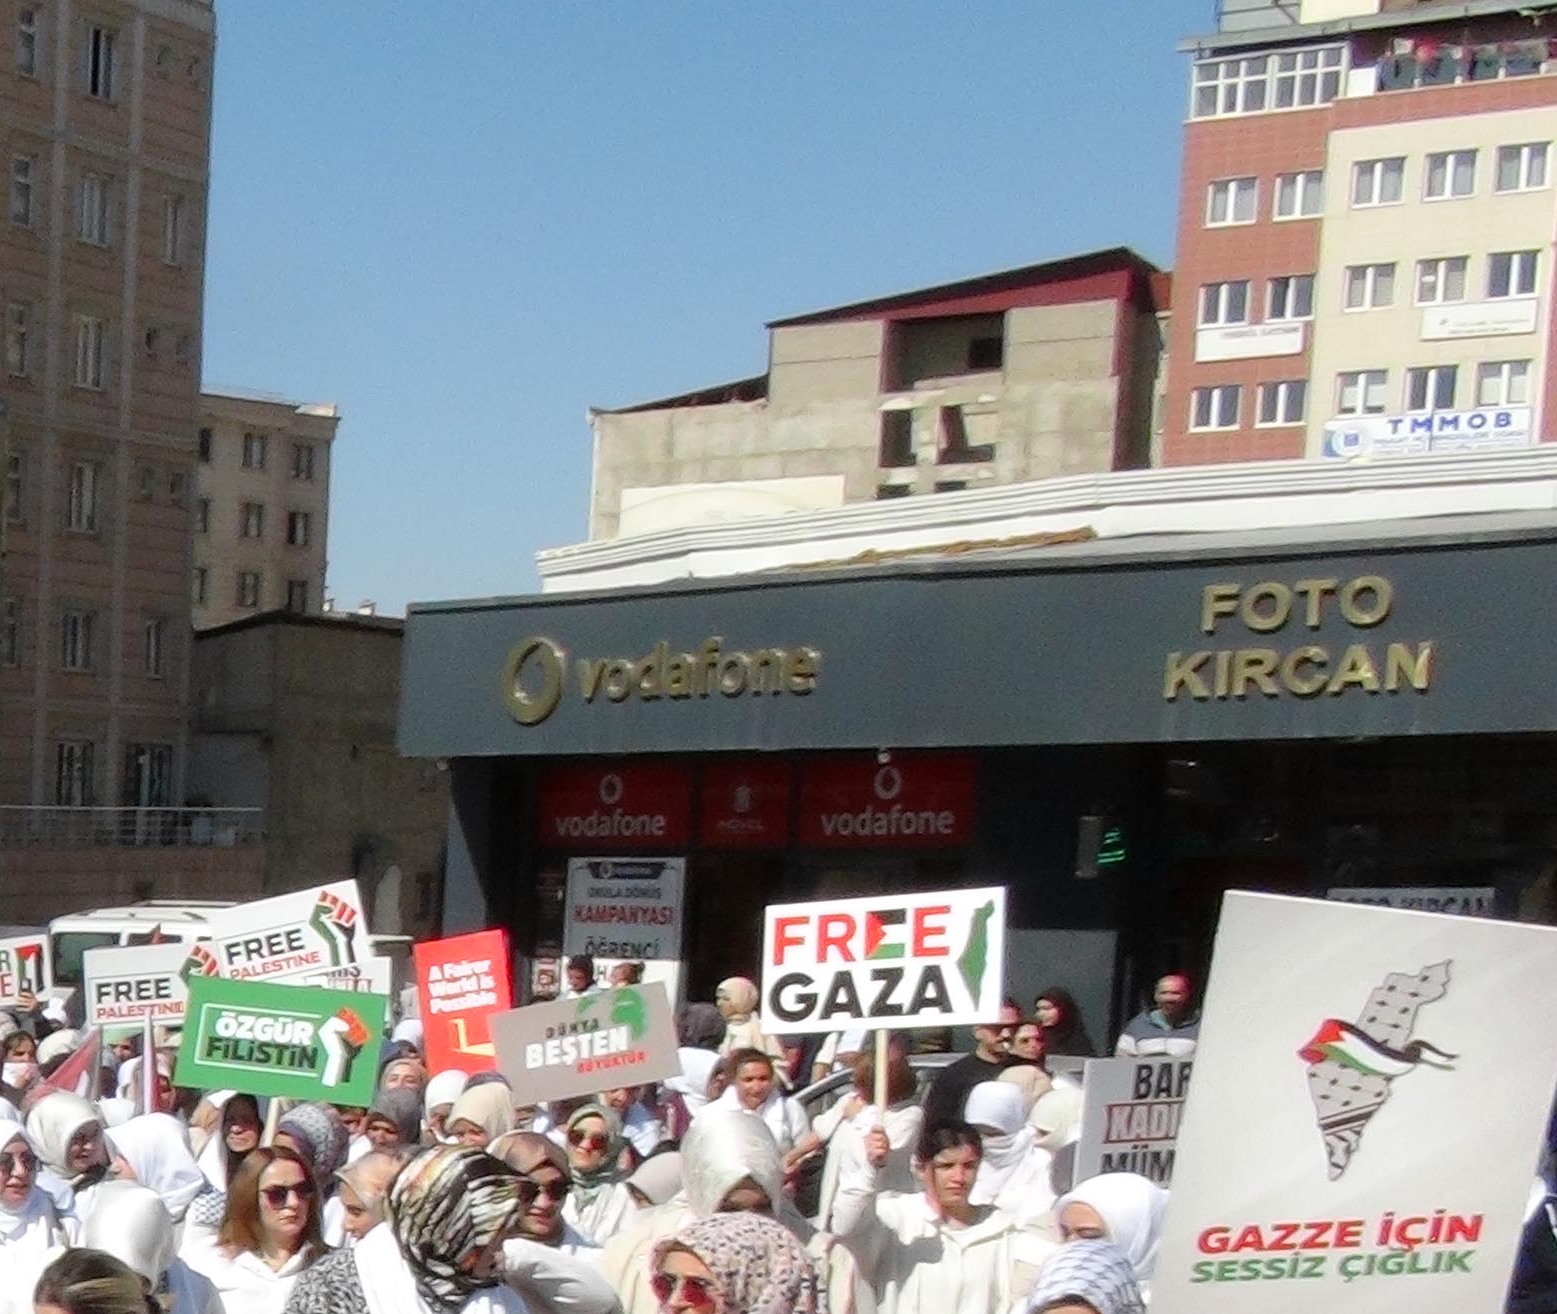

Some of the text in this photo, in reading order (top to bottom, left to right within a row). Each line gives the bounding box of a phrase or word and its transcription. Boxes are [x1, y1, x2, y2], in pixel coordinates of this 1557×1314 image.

[1387, 412, 1512, 434] TMMOB
[1200, 574, 1394, 635] FOTO
[577, 636, 822, 705] vodafone
[1161, 640, 1436, 702] KIRCAN
[555, 807, 666, 837] vodafone
[821, 805, 956, 836] vodafone
[573, 904, 676, 926] KAMPANYASI
[224, 928, 307, 966] FREE
[773, 905, 952, 966] FREE
[228, 951, 323, 980] PALESTINE
[428, 959, 493, 982] A Fairer
[95, 976, 173, 1005] FREE
[427, 973, 496, 998] World is
[429, 990, 498, 1014] Possible
[768, 964, 954, 1023] GAZA
[96, 1000, 185, 1020] PALESTINE
[214, 1011, 316, 1046] ÖZGÜR
[544, 1017, 600, 1040] DÜNYA
[204, 1036, 318, 1070] FİLİSTİN
[525, 1026, 631, 1070] BEŞTEN
[1131, 1061, 1193, 1101] BAR
[1106, 1104, 1182, 1141] KADI
[1100, 1143, 1177, 1184] MÜM
[1196, 1209, 1485, 1254] GAZZE İÇİN
[1189, 1246, 1477, 1284] SESSİZ ÇIĞLIK
